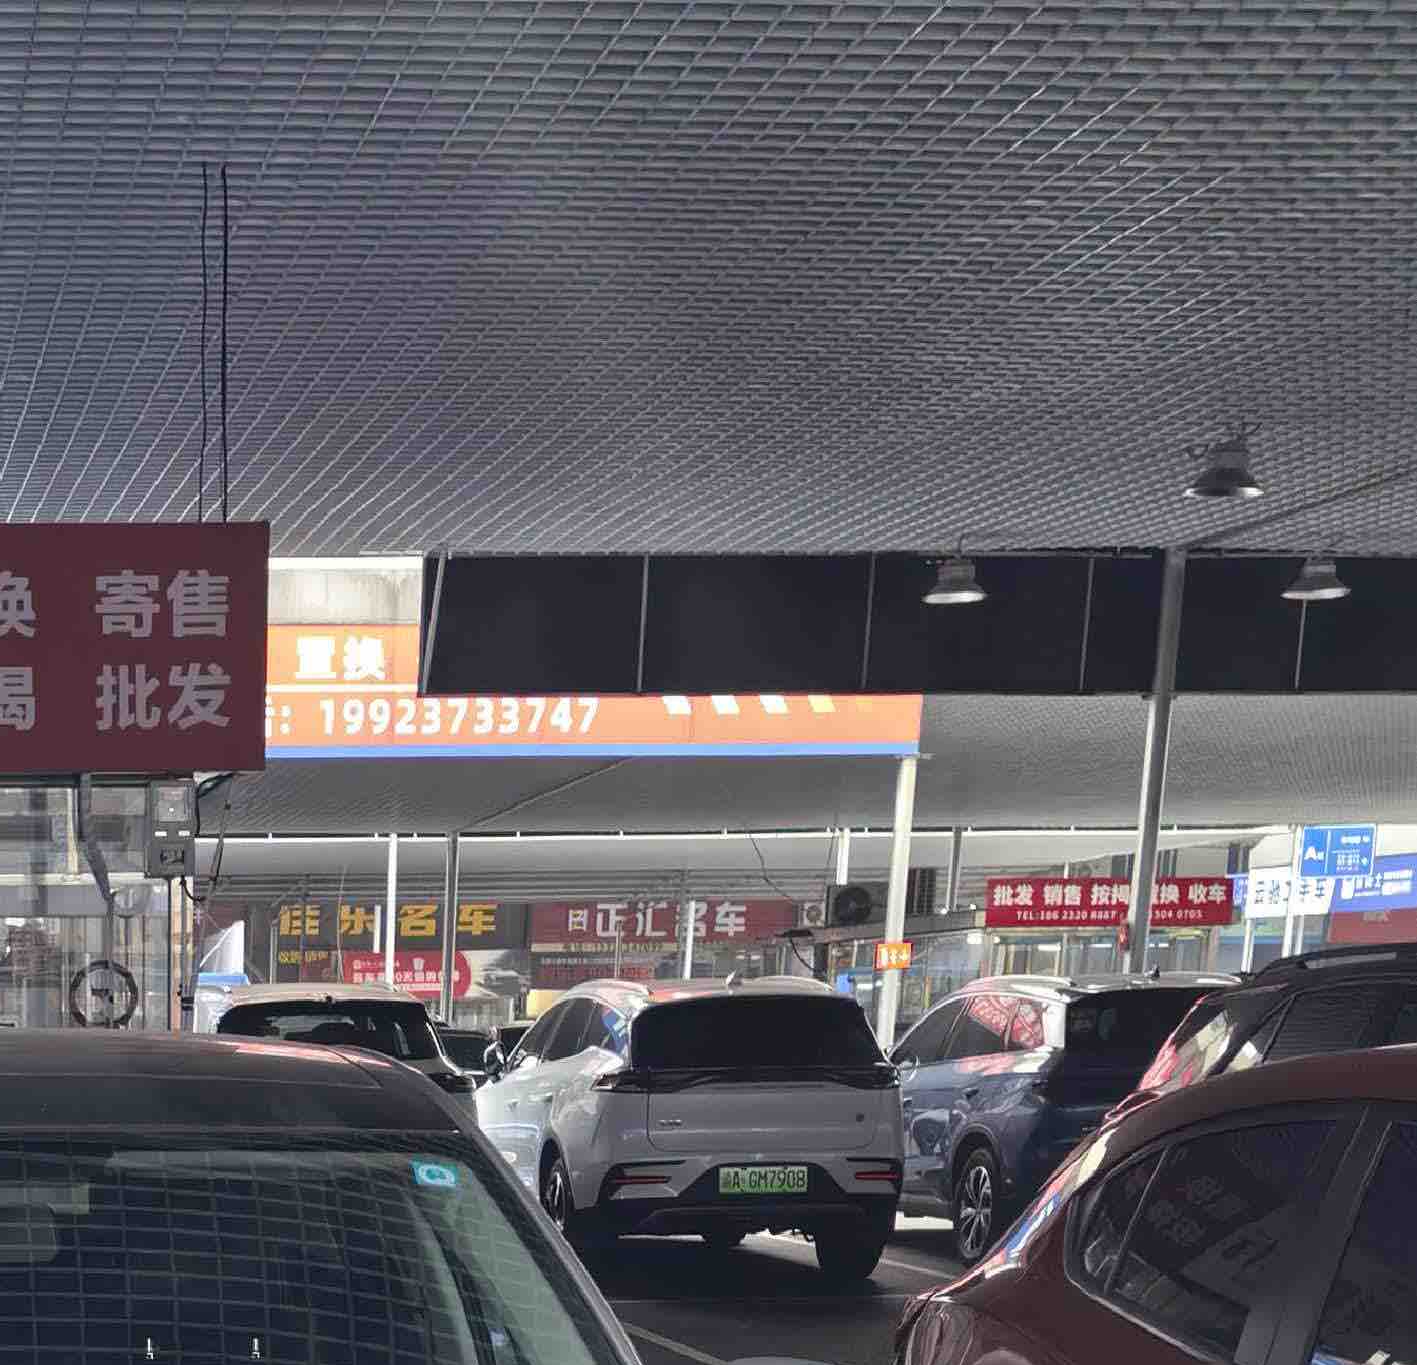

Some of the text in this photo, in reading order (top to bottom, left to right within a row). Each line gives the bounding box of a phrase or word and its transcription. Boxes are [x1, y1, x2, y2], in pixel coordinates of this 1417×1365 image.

[95, 569, 230, 639] 寄售
[95, 662, 232, 732] 批发
[993, 884, 1034, 907] 批发
[1043, 883, 1082, 906] 销售
[1187, 883, 1227, 904] 收车
